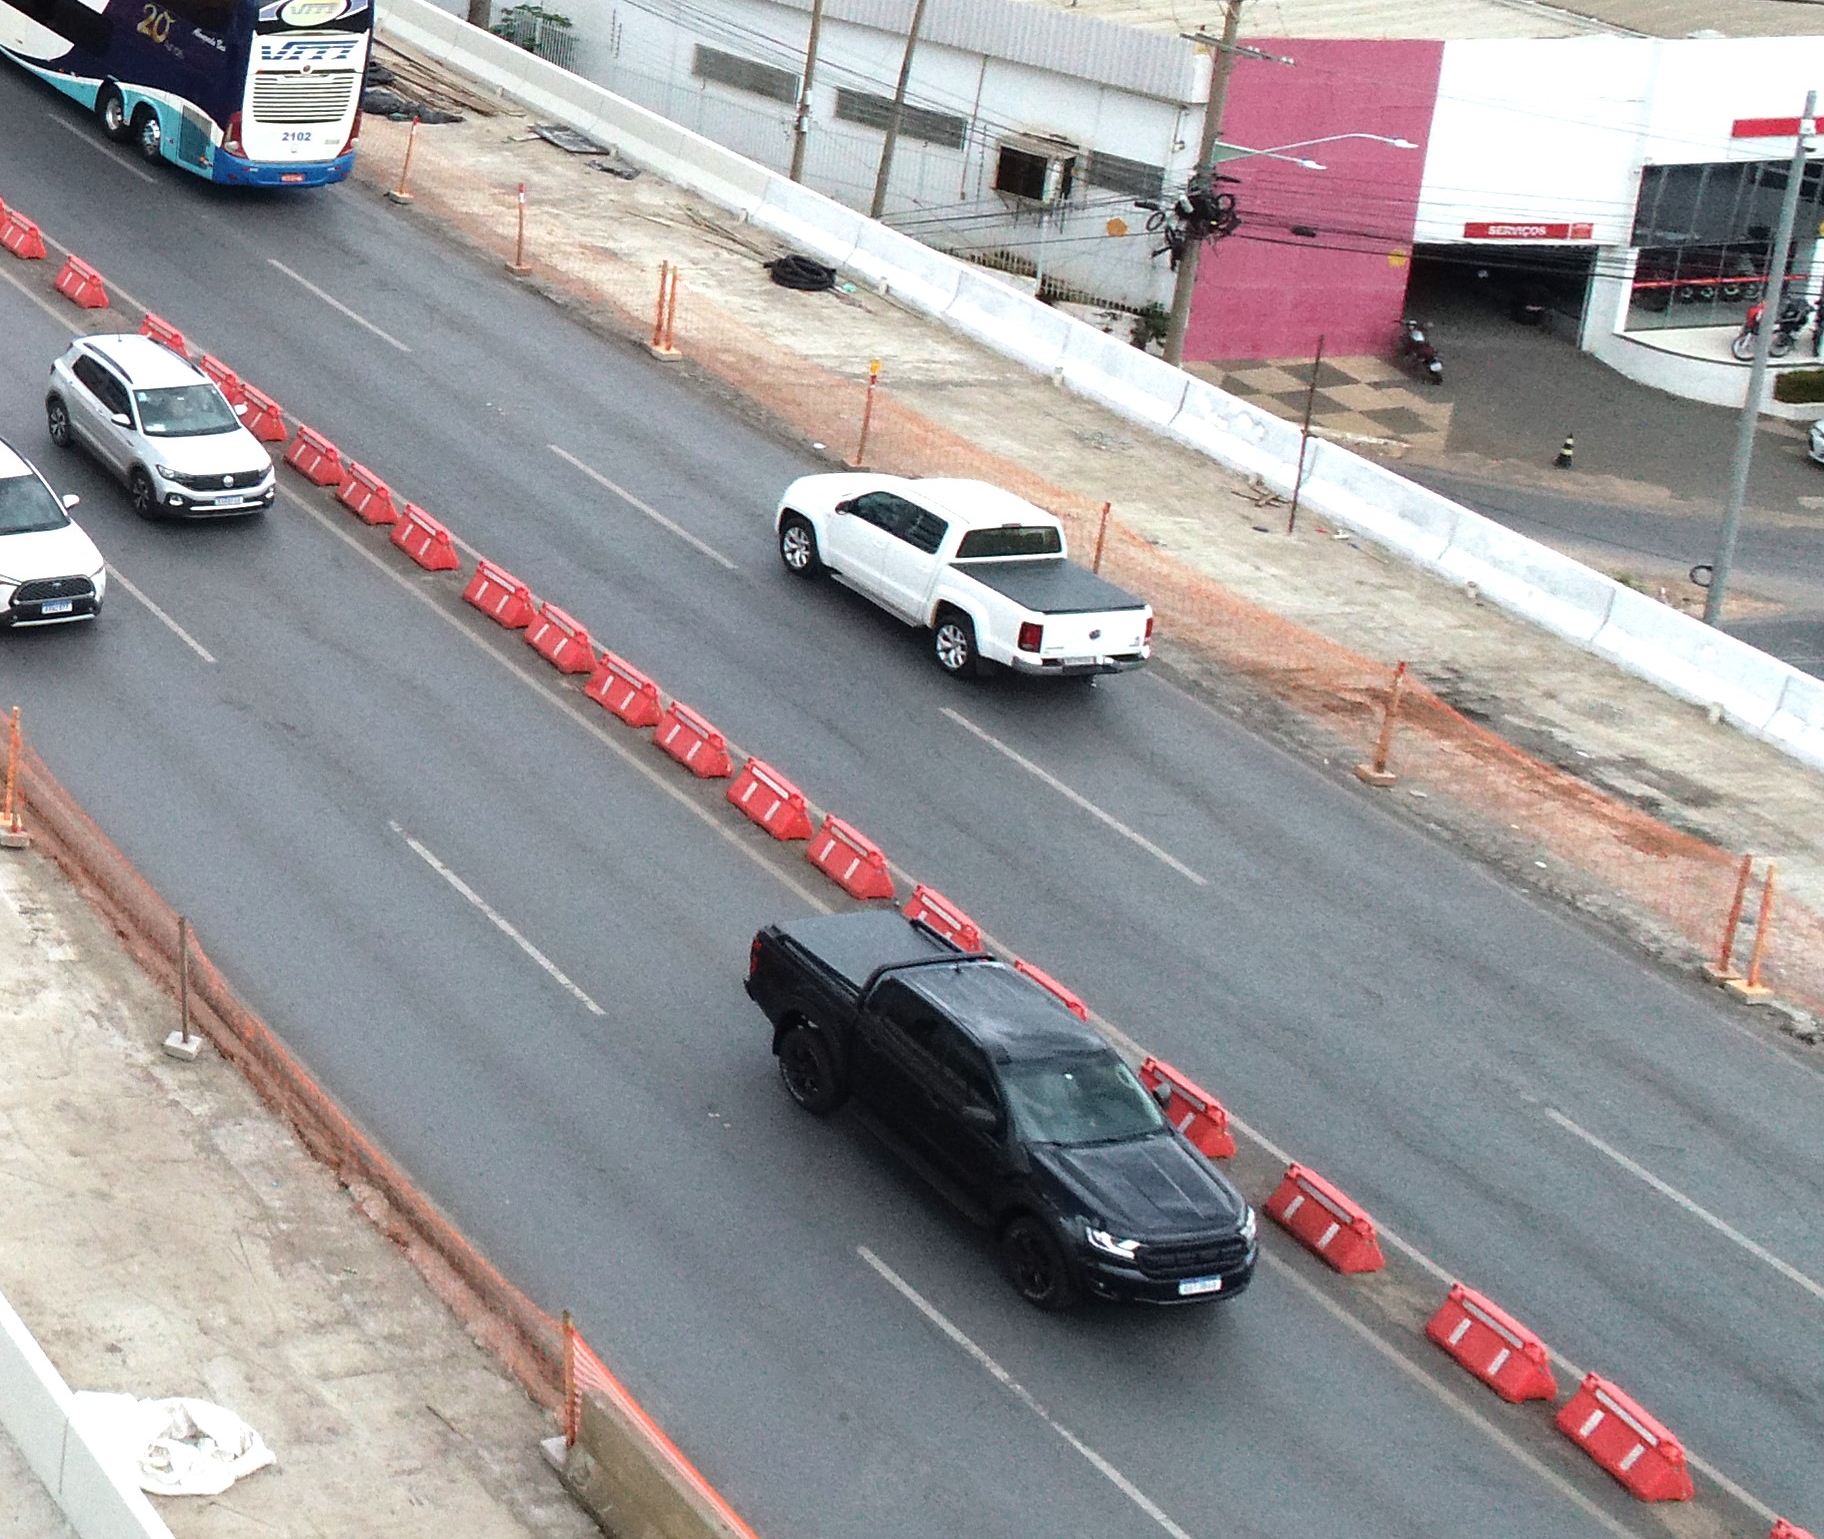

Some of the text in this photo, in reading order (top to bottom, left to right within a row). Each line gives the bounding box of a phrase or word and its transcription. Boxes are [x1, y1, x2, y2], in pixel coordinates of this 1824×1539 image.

[137, 3, 176, 43] 20
[282, 132, 312, 141] 2102
[1488, 226, 1546, 236] SERVIÇOS
